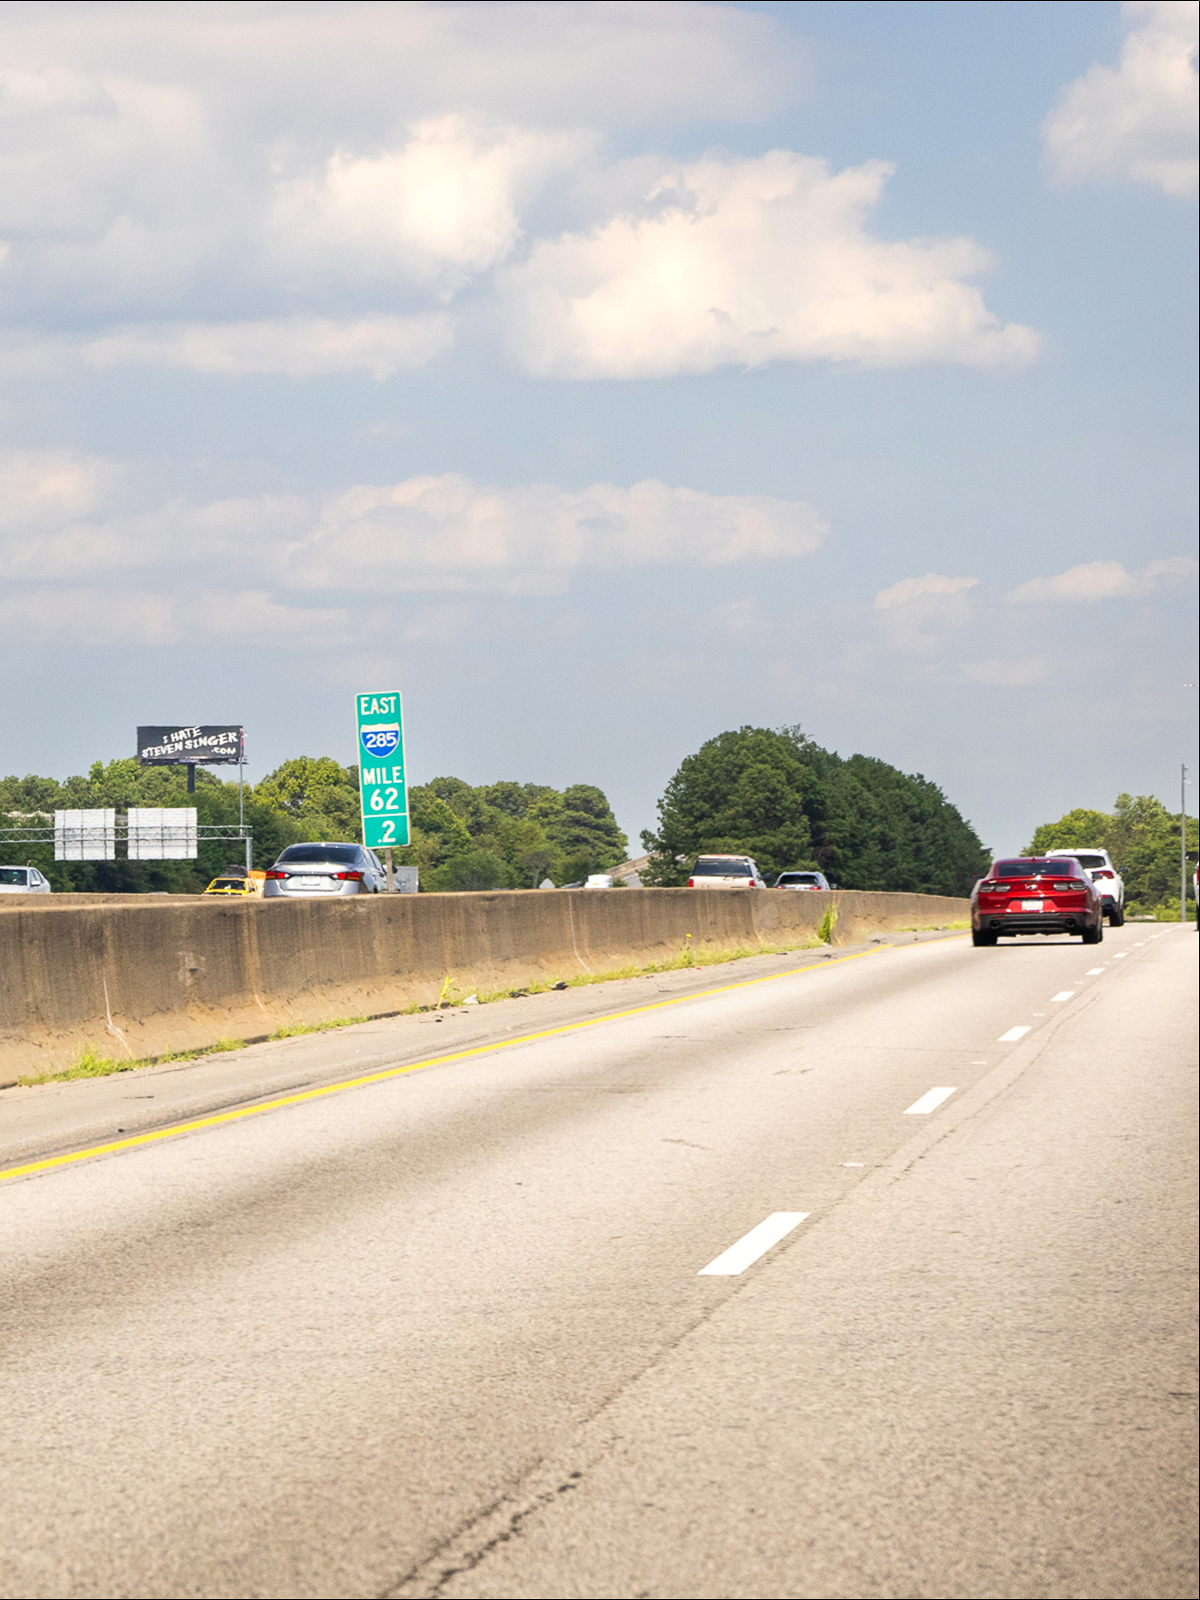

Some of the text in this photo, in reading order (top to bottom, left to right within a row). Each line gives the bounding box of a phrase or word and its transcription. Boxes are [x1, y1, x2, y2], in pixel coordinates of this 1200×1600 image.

[360, 696, 397, 715] EAST
[163, 726, 202, 744] I HATE
[366, 732, 397, 748] 285
[141, 732, 238, 758] STEVEN SINGER
[363, 766, 403, 785] MILE
[370, 787, 399, 811] 62
[377, 820, 396, 843] .2
